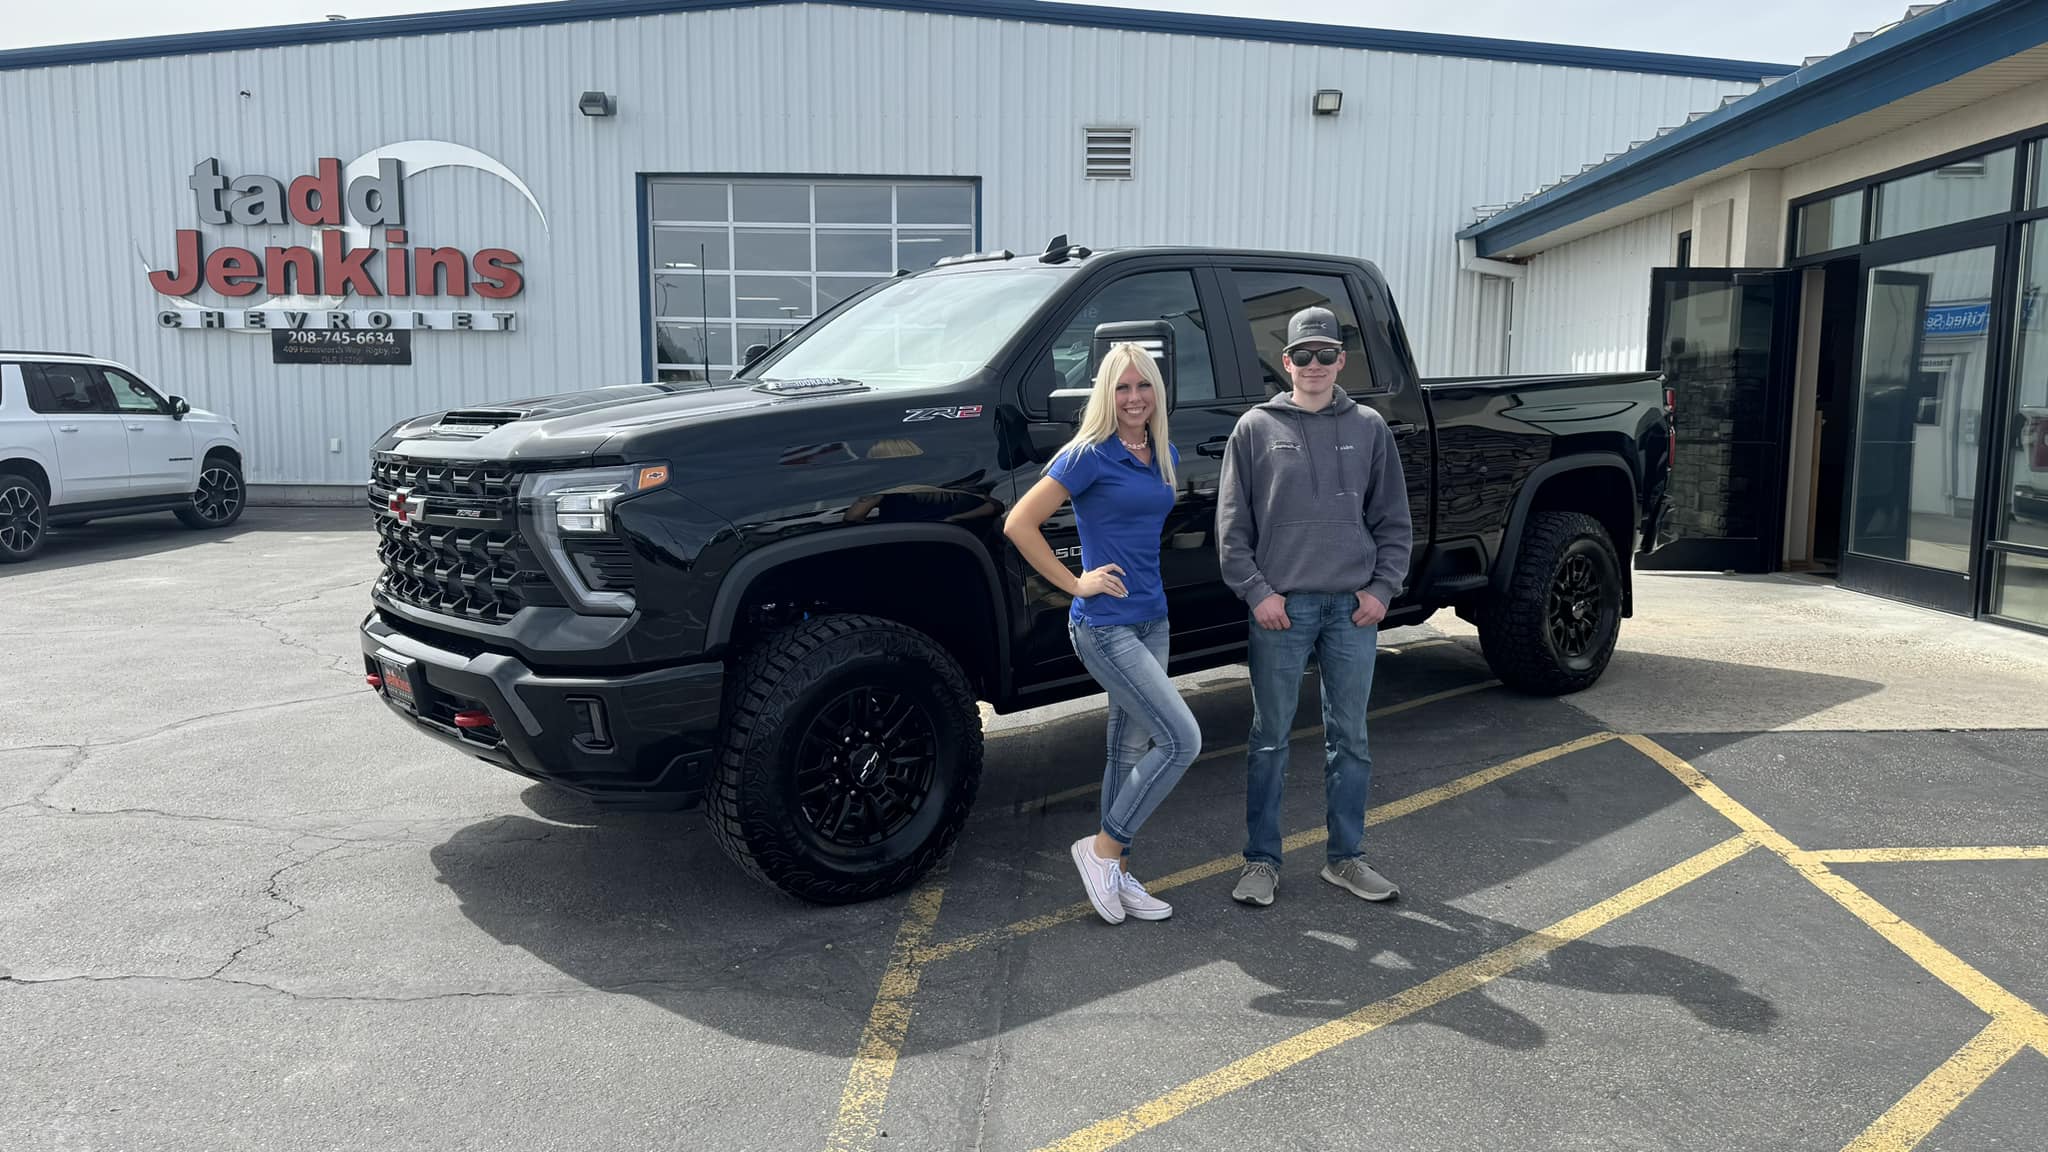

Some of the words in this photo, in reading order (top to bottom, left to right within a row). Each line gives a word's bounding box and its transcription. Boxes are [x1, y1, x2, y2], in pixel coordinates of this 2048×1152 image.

[189, 157, 405, 226] tadd
[148, 229, 524, 298] Jenkins
[157, 310, 514, 329] CHEVROLET
[288, 331, 395, 345] 208-745-6634
[902, 404, 983, 423] ZR2
